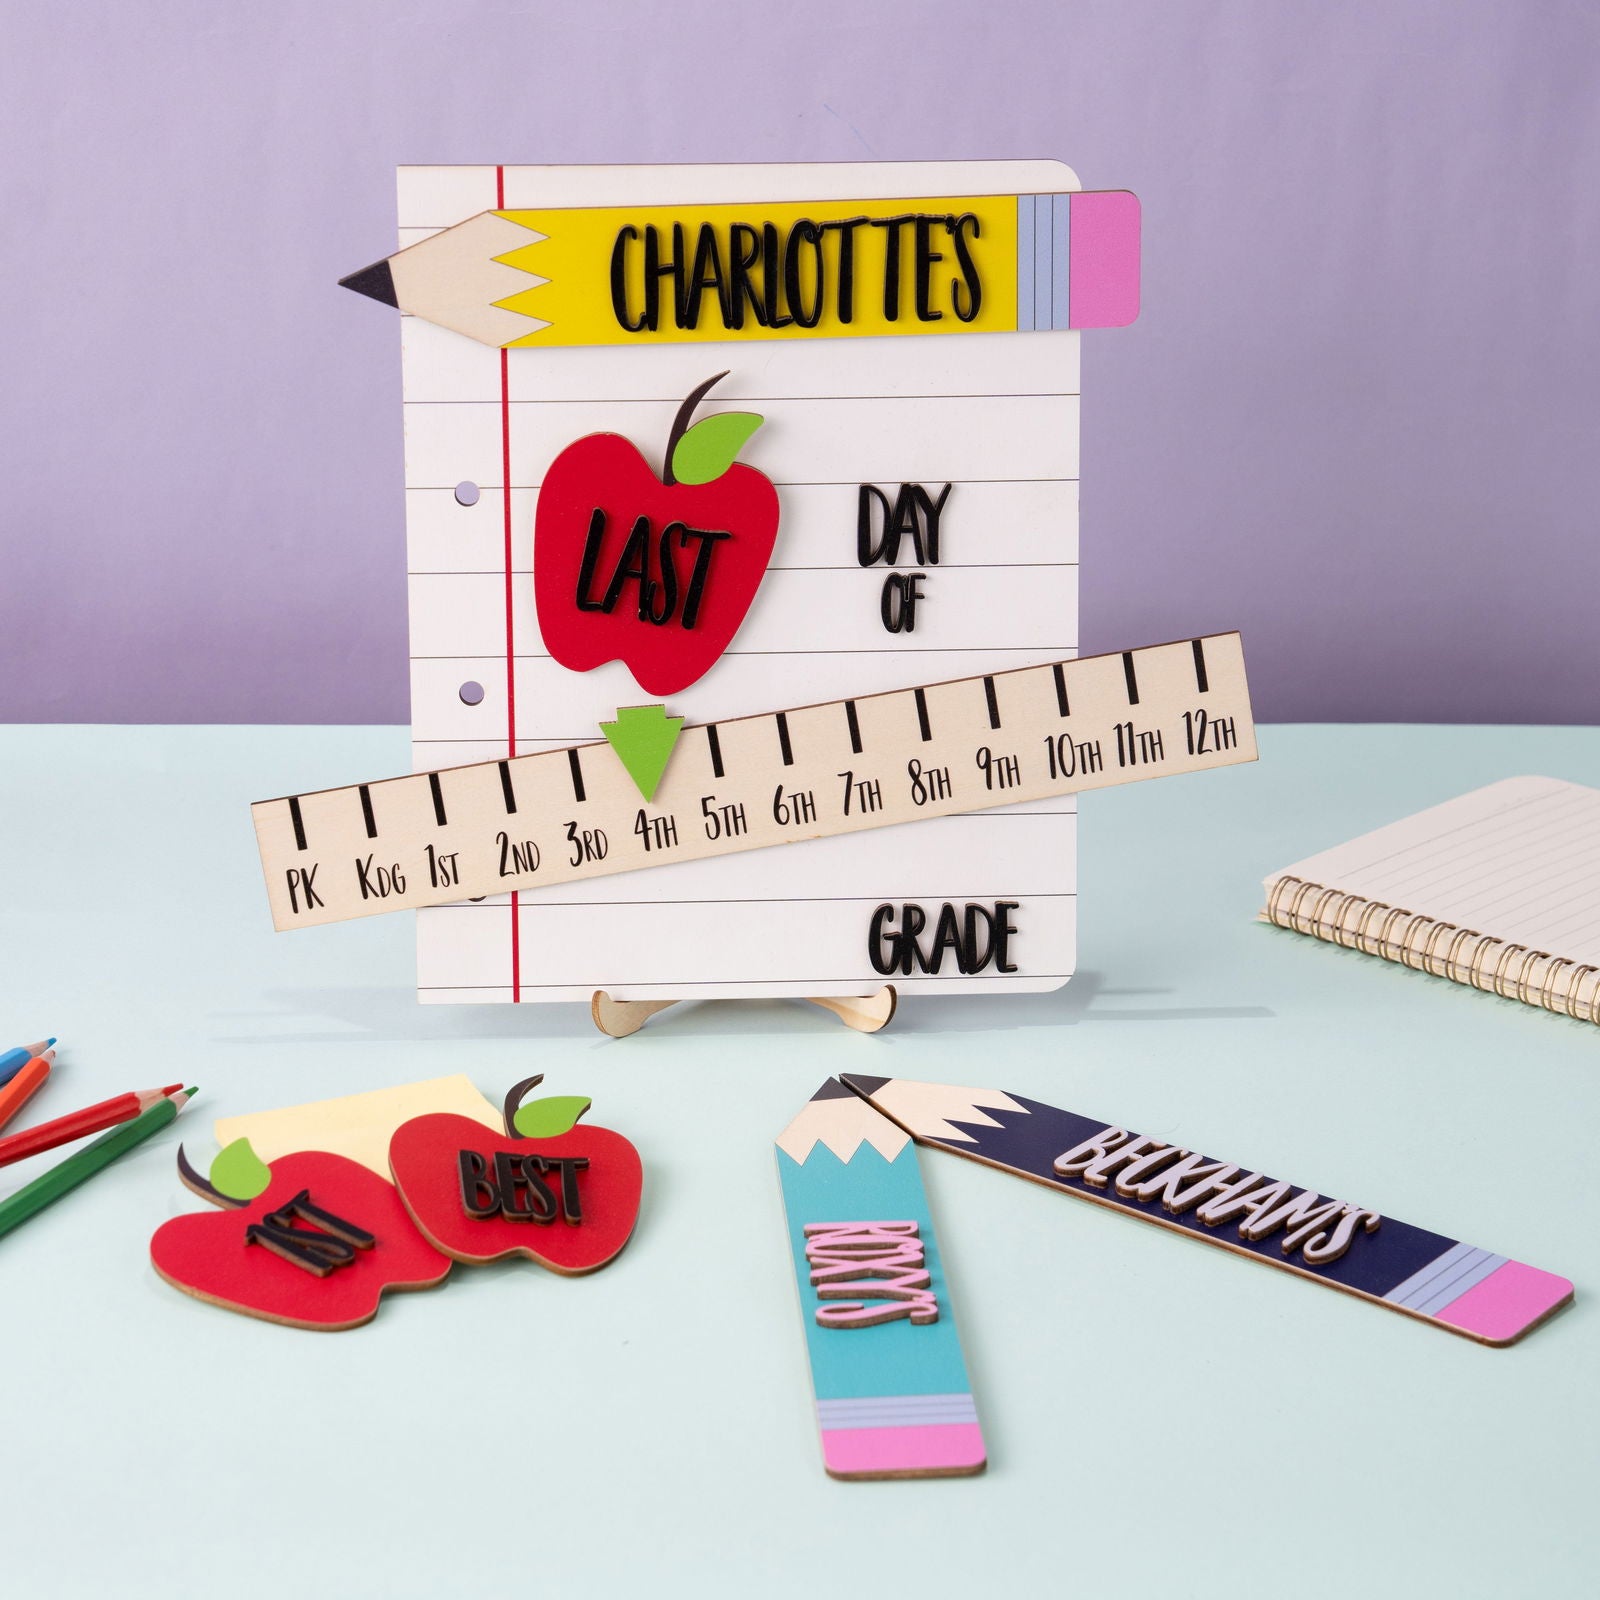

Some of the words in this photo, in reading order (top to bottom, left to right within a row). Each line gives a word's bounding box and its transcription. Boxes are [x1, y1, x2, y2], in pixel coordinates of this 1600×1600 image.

[858, 482, 952, 568] DAY
[576, 507, 732, 629] LAST
[880, 572, 926, 634] OF
[286, 864, 324, 914] PK
[496, 831, 541, 877] 2ND
[563, 821, 609, 867] 3RD
[634, 809, 679, 852] 4TH
[701, 796, 748, 841] 5TH
[772, 785, 817, 826] 6TH
[837, 771, 883, 816] 7TH
[907, 759, 953, 806] 8TH
[975, 746, 1022, 791] 9TH
[1043, 733, 1104, 780] 10TH
[1112, 722, 1165, 766] 11TH
[1181, 709, 1239, 755] 12TH
[868, 901, 1020, 976] GRADE
[457, 1149, 590, 1226] BEST
